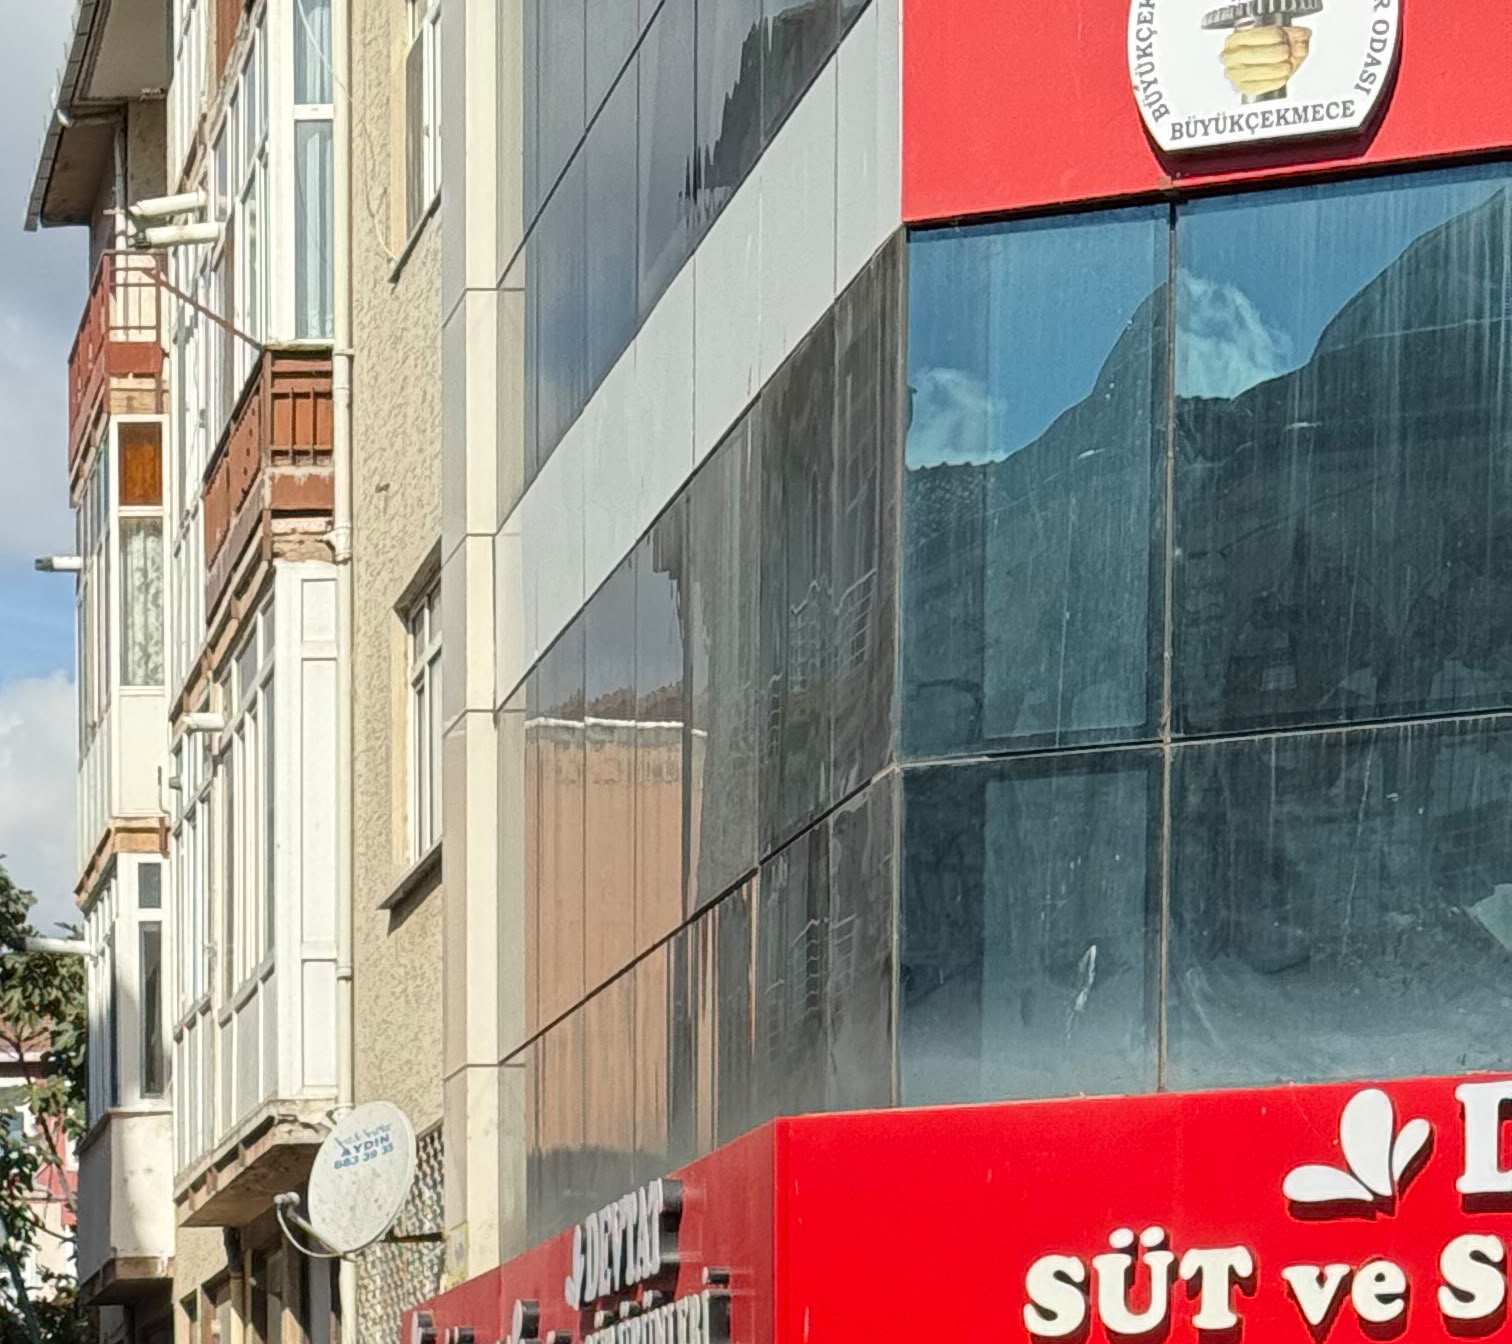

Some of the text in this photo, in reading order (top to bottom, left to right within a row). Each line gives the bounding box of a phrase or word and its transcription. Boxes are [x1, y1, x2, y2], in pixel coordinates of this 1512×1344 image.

[1354, 19, 1390, 96] ODASI
[1170, 99, 1356, 141] BÜYÜKÇEKMECE
[1022, 1225, 1254, 1338] SÜT
[1281, 1259, 1407, 1327] ve
